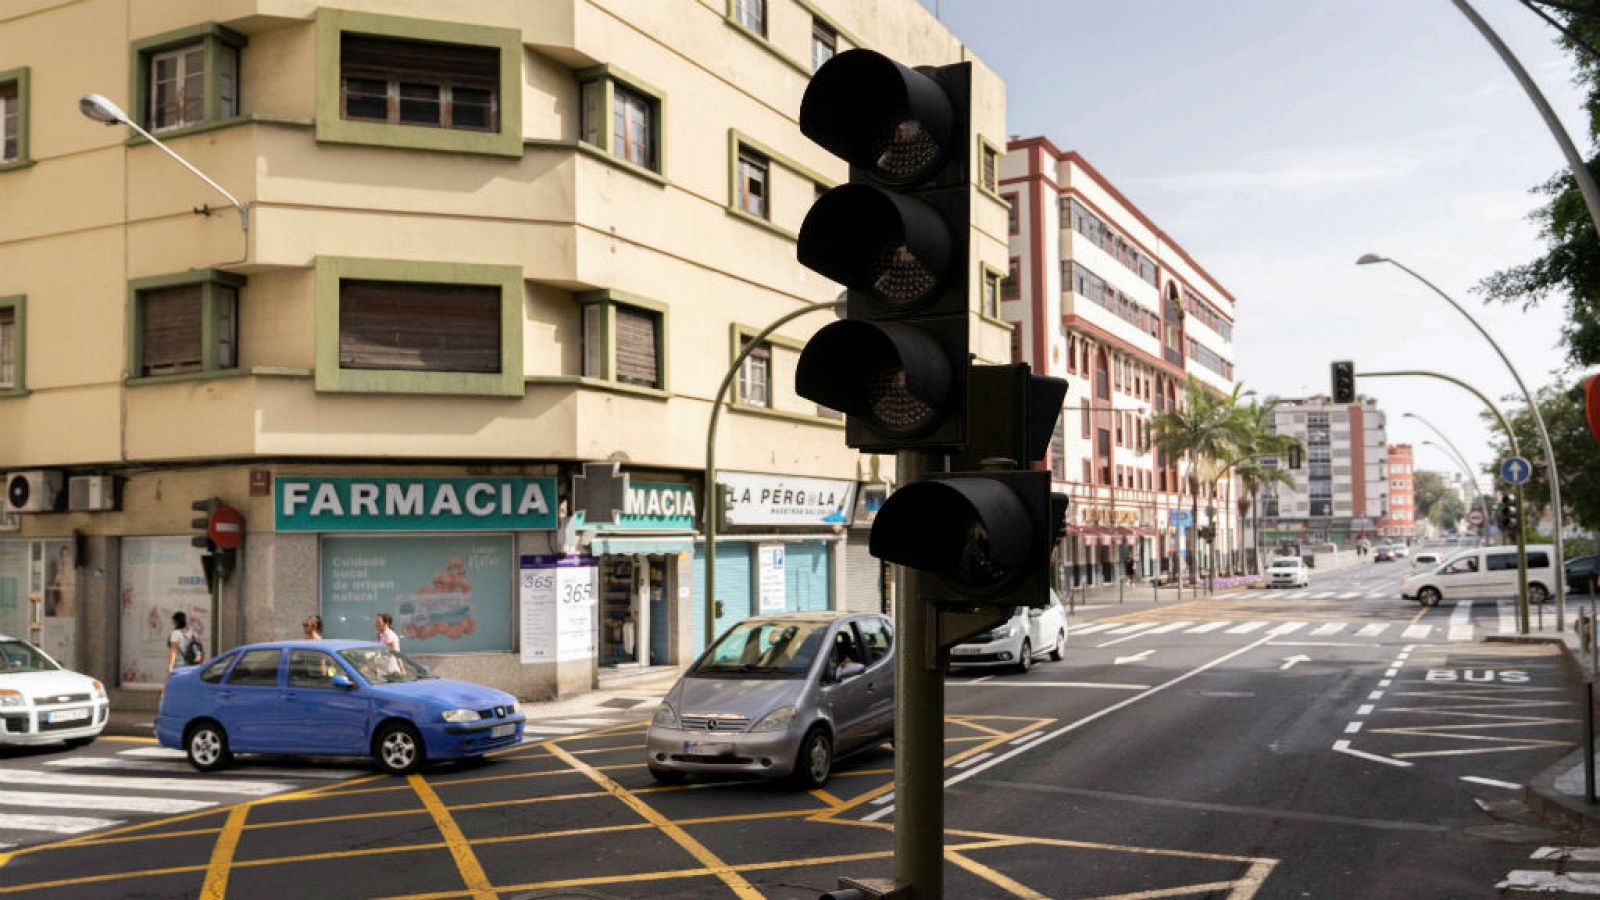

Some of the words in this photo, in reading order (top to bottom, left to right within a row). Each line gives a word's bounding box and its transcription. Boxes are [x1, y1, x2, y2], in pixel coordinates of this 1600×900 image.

[283, 482, 549, 516] FARMACIA
[730, 488, 751, 503] LA
[624, 488, 696, 517] MACIA
[332, 555, 386, 567] Cuidado
[332, 568, 368, 578] bucal
[332, 579, 349, 590] de
[352, 580, 395, 591] origen
[525, 576, 554, 589] 365
[332, 591, 377, 601] natural
[1424, 669, 1531, 682] BUS
